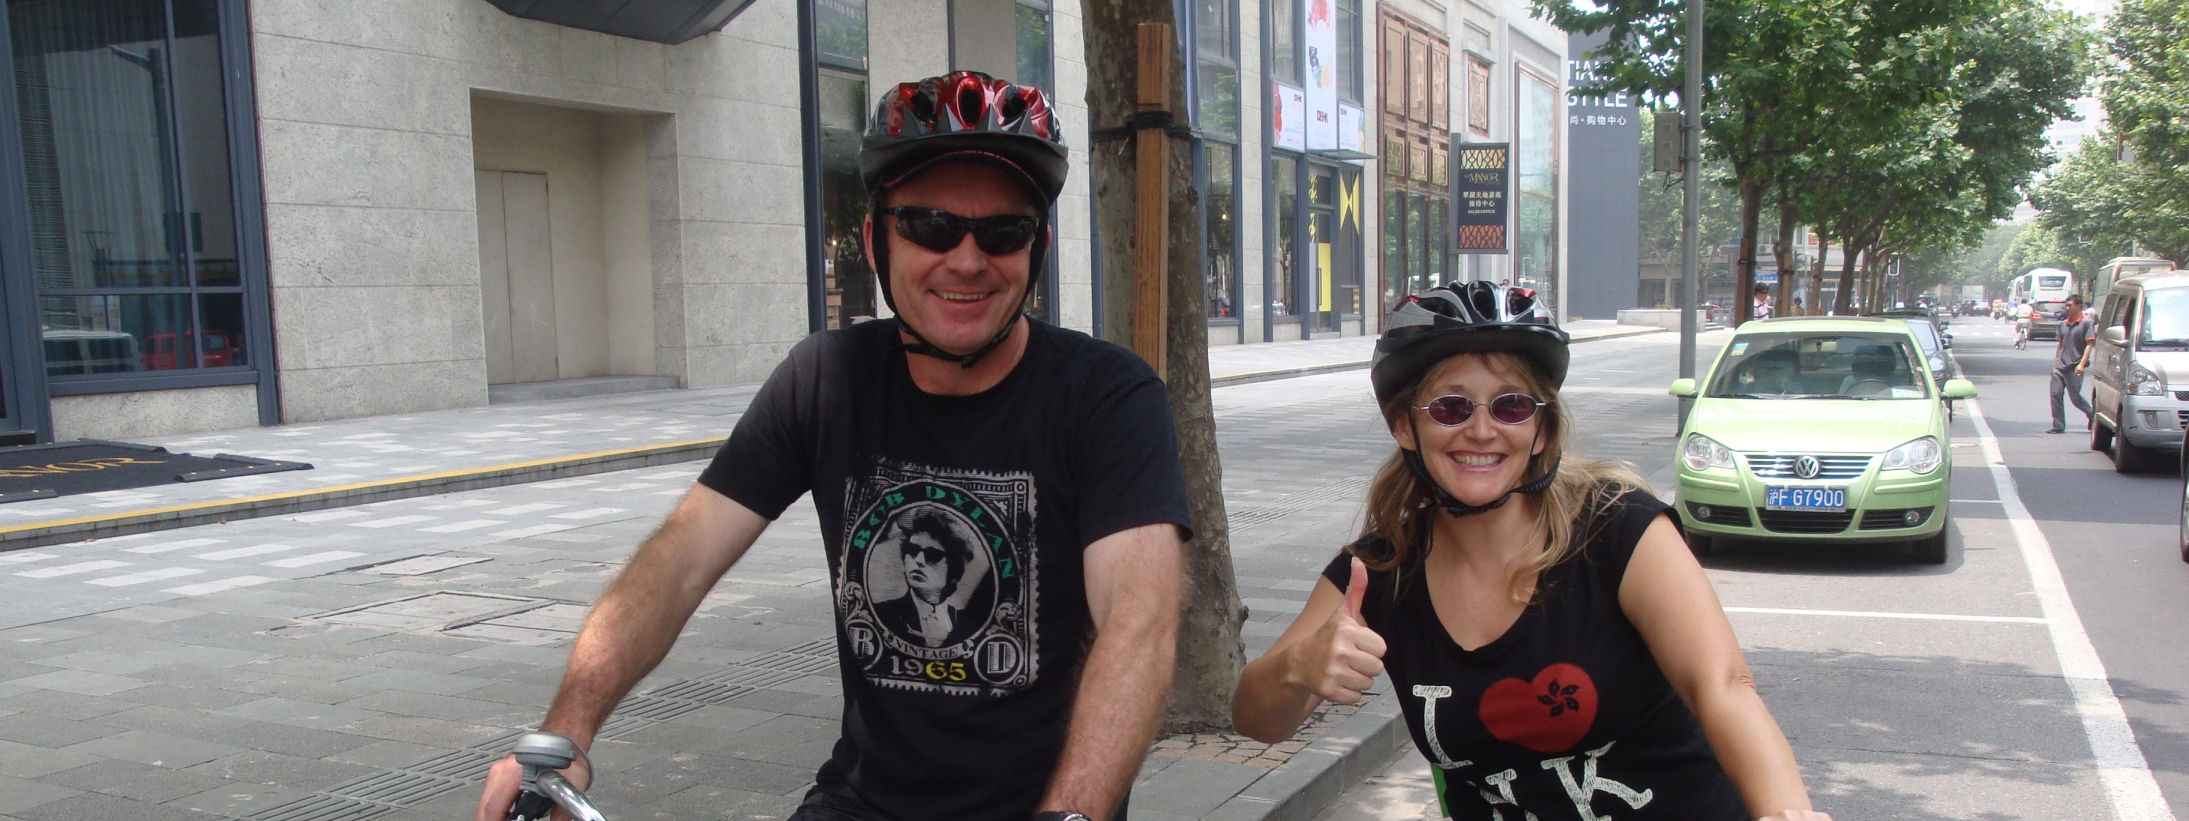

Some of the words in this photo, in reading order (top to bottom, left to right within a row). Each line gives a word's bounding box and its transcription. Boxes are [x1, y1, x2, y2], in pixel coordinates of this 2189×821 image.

[1792, 489, 1844, 507] G7900
[853, 491, 905, 550] BOB
[924, 485, 1016, 579] DYLAN
[894, 641, 960, 660] VINTAGE
[987, 641, 1017, 674] D
[889, 655, 967, 682] 1965
[1412, 684, 1474, 770] I
